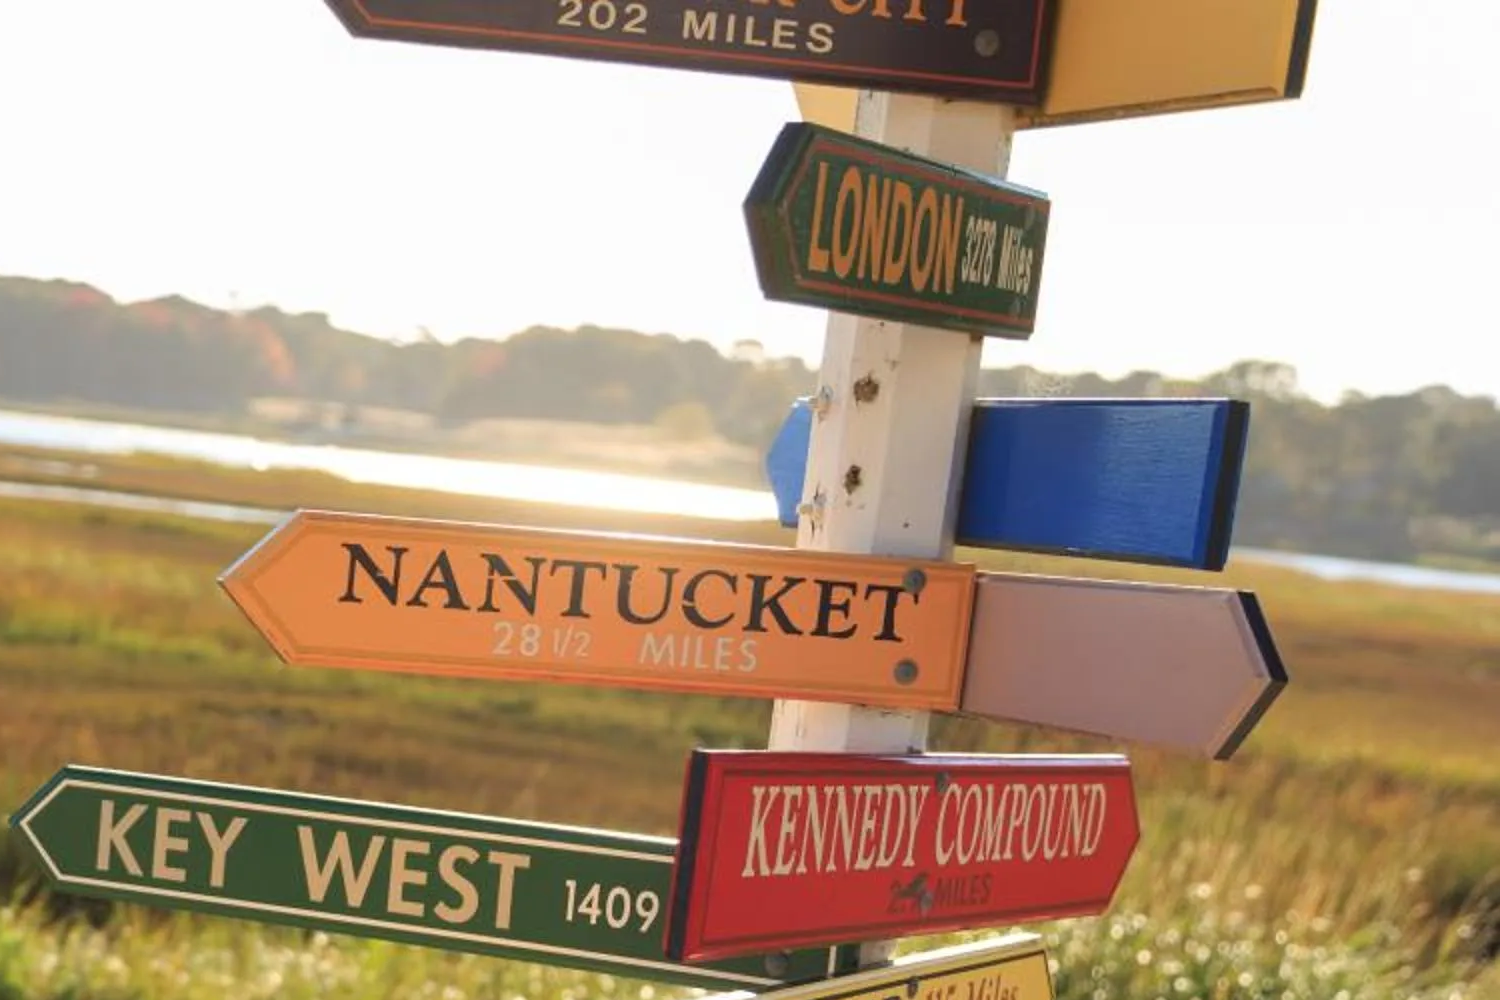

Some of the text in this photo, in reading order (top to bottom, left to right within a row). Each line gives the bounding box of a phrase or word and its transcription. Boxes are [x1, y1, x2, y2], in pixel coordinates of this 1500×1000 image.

[558, 0, 648, 34] 202
[682, 10, 836, 53] MILES
[808, 161, 964, 294] LONDON
[997, 224, 1034, 295] Miles
[338, 543, 921, 643] NANTUCKET
[492, 621, 758, 674] 28 1/2 MILES
[96, 799, 660, 934] KEY WEST 1409
[741, 783, 1108, 877] KENNEDY COMPOUND
[934, 872, 994, 908] MILES
